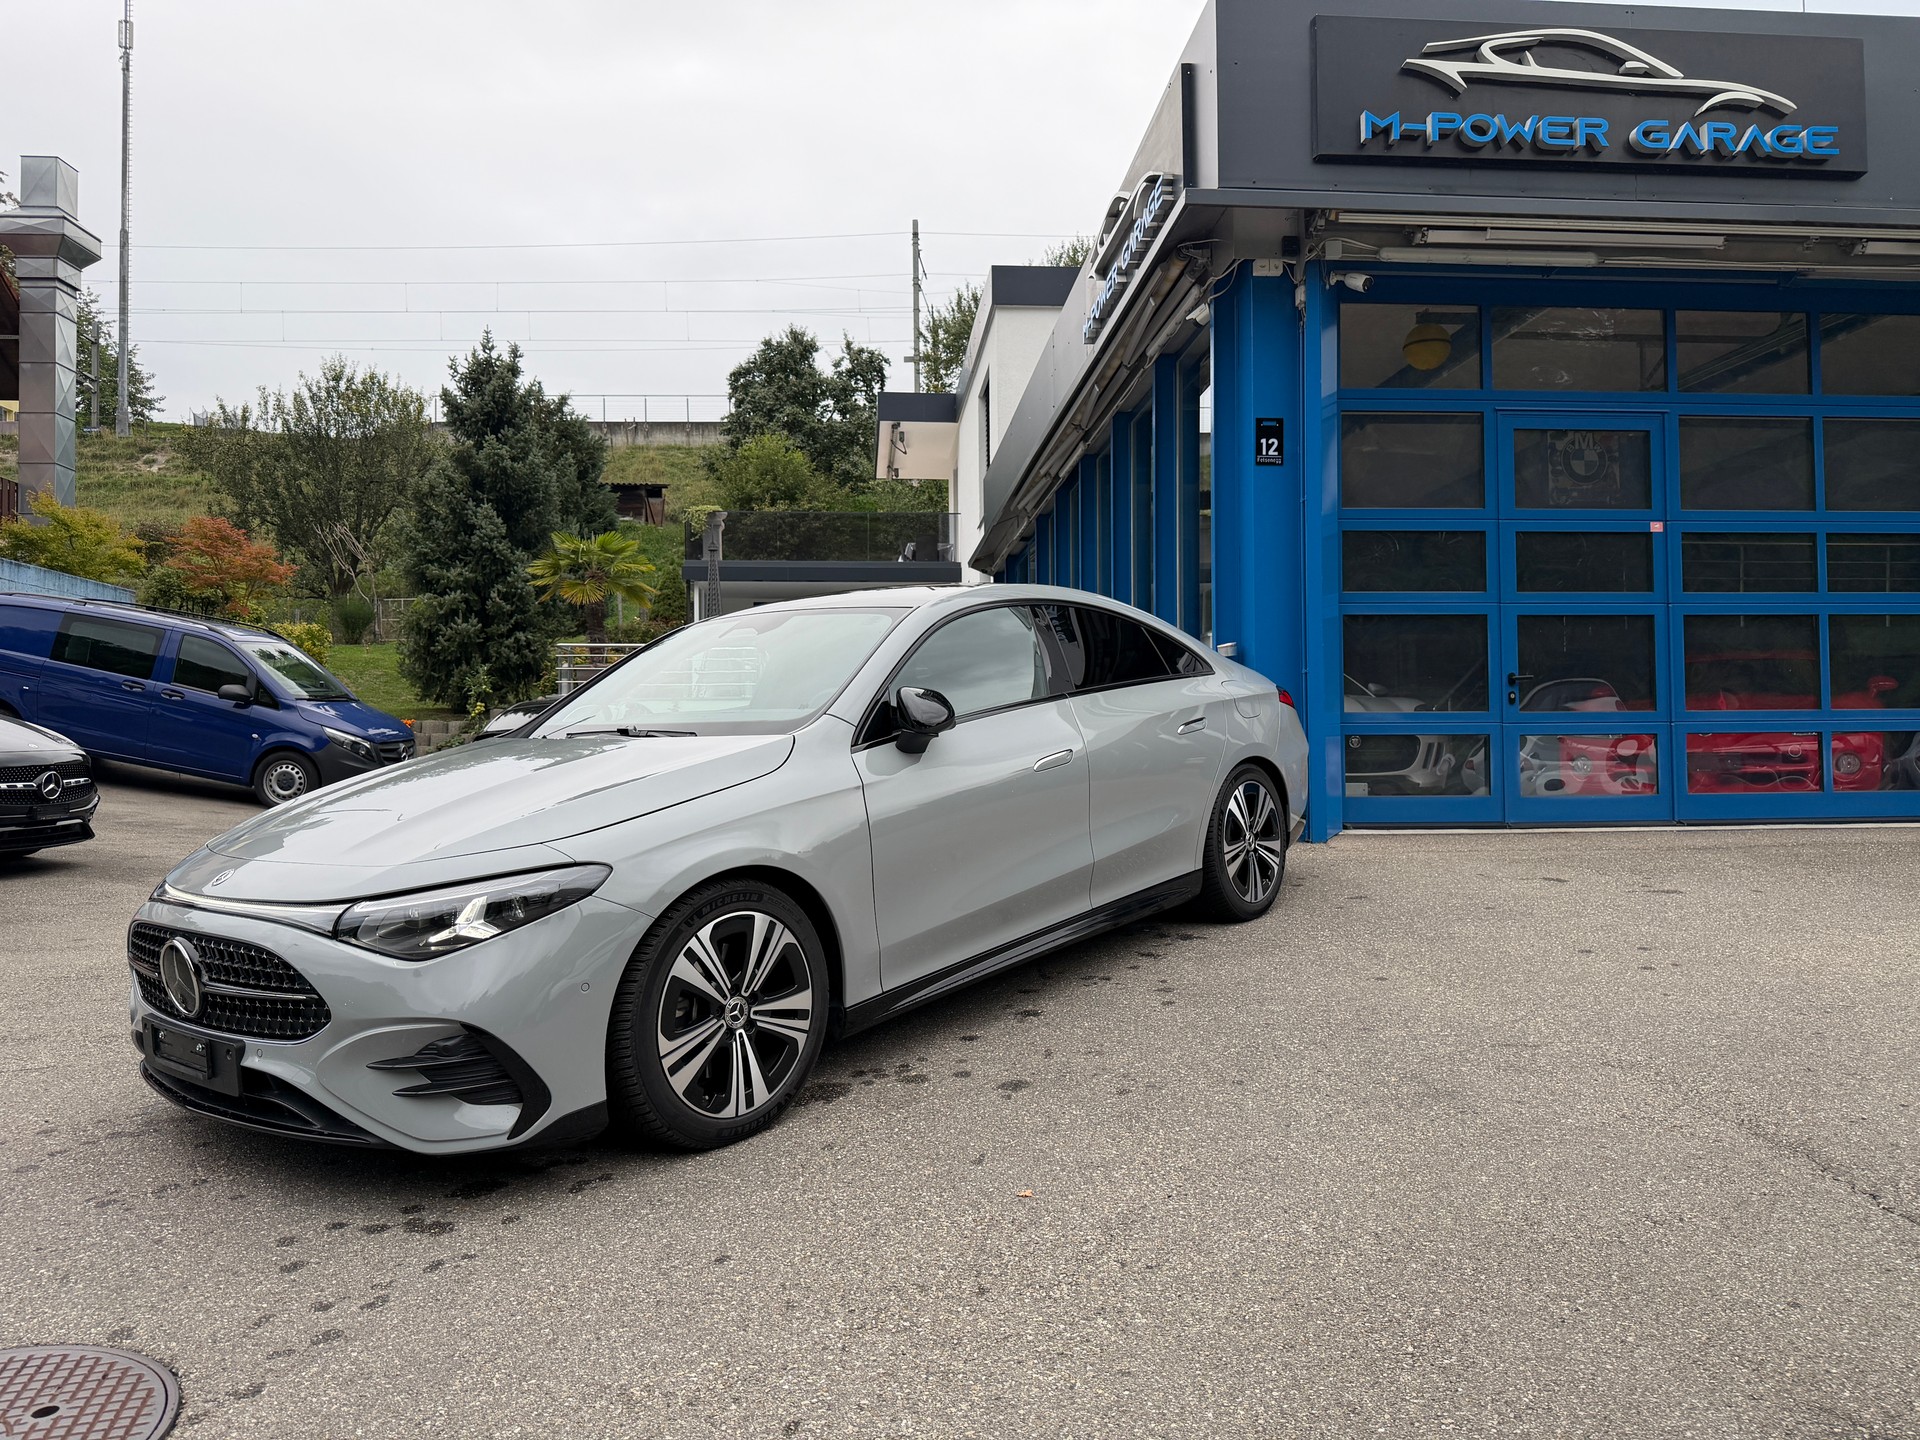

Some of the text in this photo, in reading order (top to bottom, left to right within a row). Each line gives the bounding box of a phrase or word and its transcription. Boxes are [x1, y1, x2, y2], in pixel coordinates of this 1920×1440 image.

[1361, 110, 1840, 158] M-POWER GARAGE
[1121, 174, 1164, 270] GARAGE
[1260, 438, 1279, 456] 12
[701, 893, 761, 915] MICHELIN
